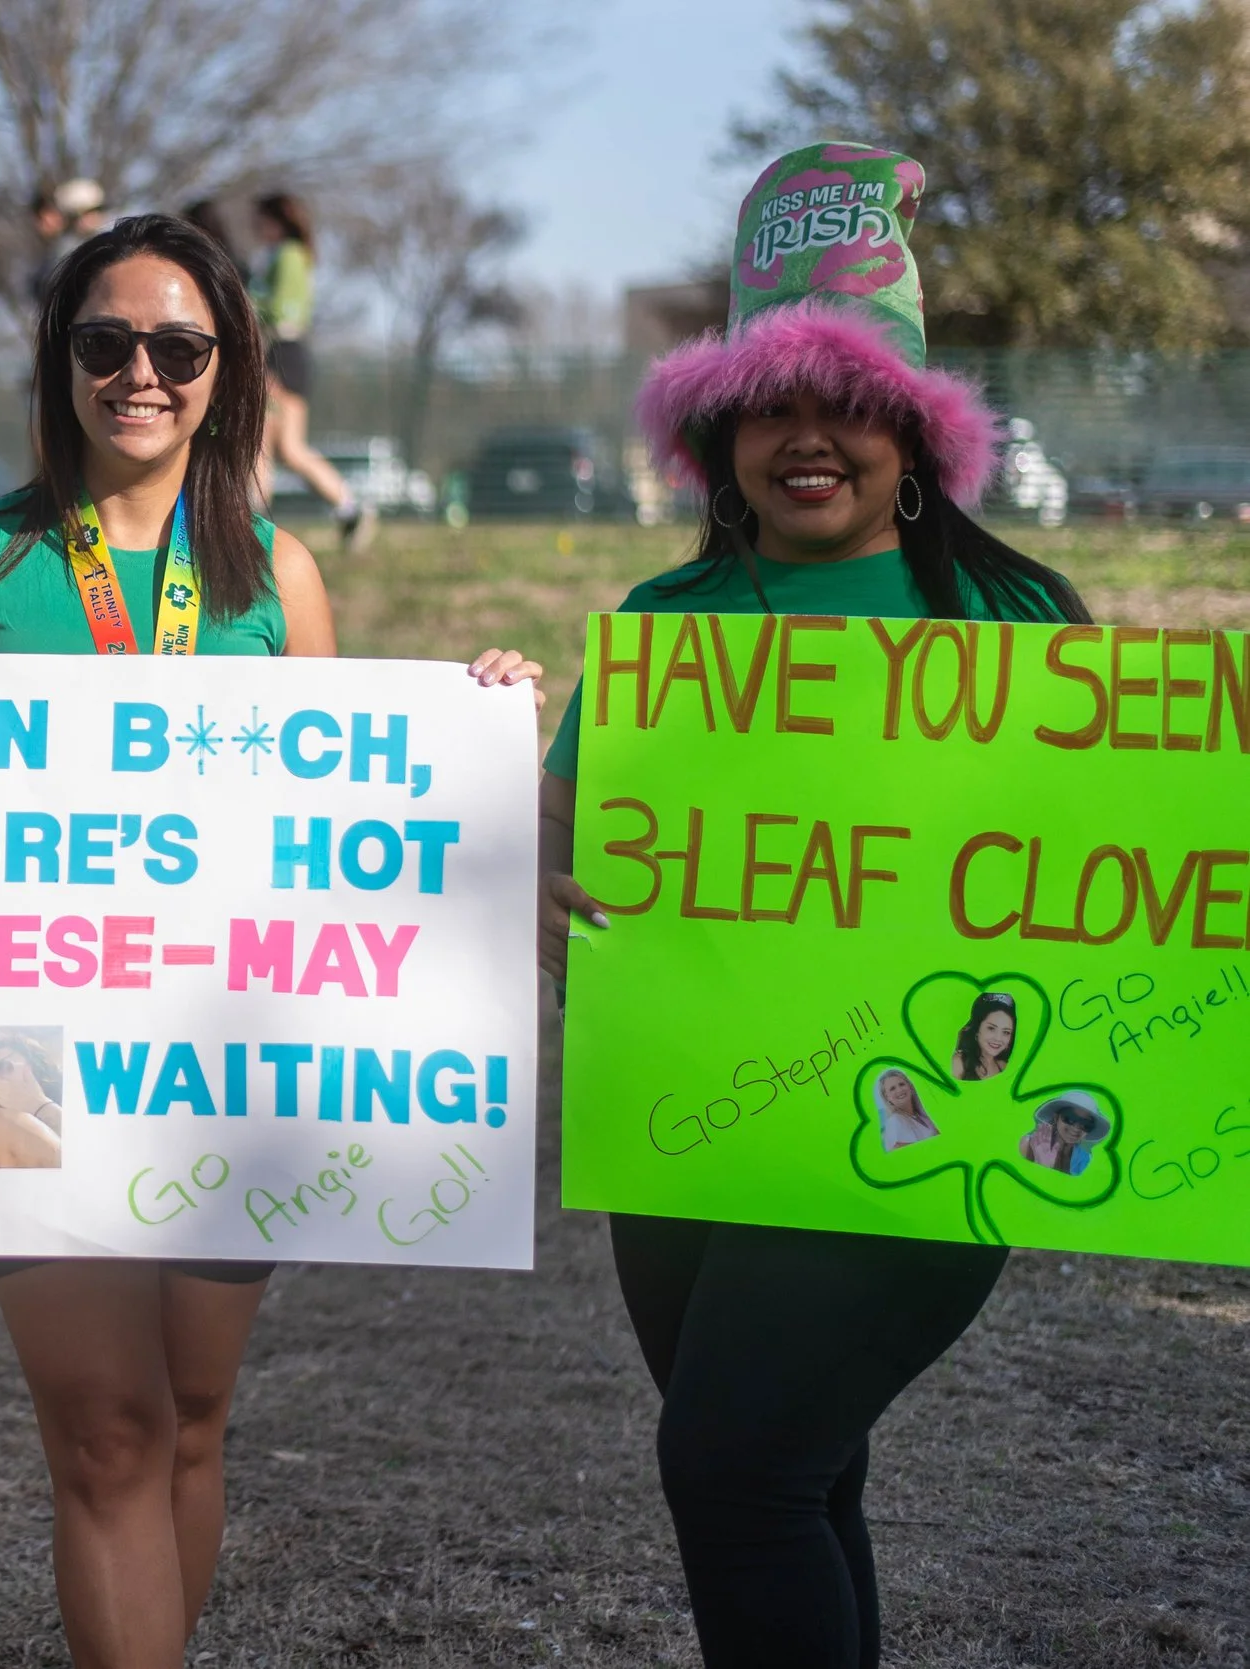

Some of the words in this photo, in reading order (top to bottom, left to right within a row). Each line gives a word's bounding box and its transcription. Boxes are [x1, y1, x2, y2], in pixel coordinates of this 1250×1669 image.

[761, 192, 804, 221] KISS
[808, 184, 844, 208] ME
[847, 182, 885, 202] I'M
[88, 586, 106, 621] FALLS
[101, 583, 123, 628] TRINITY
[173, 587, 186, 603] 5K
[175, 624, 190, 644] RUN
[595, 614, 846, 735] HAVE
[867, 619, 1013, 741] YOU
[270, 815, 460, 894] HOT
[598, 798, 910, 928] 3-LEAF
[950, 832, 1250, 951] CLOVE
[74, 1041, 508, 1129] WAITING!
[245, 1142, 374, 1243] Angie
